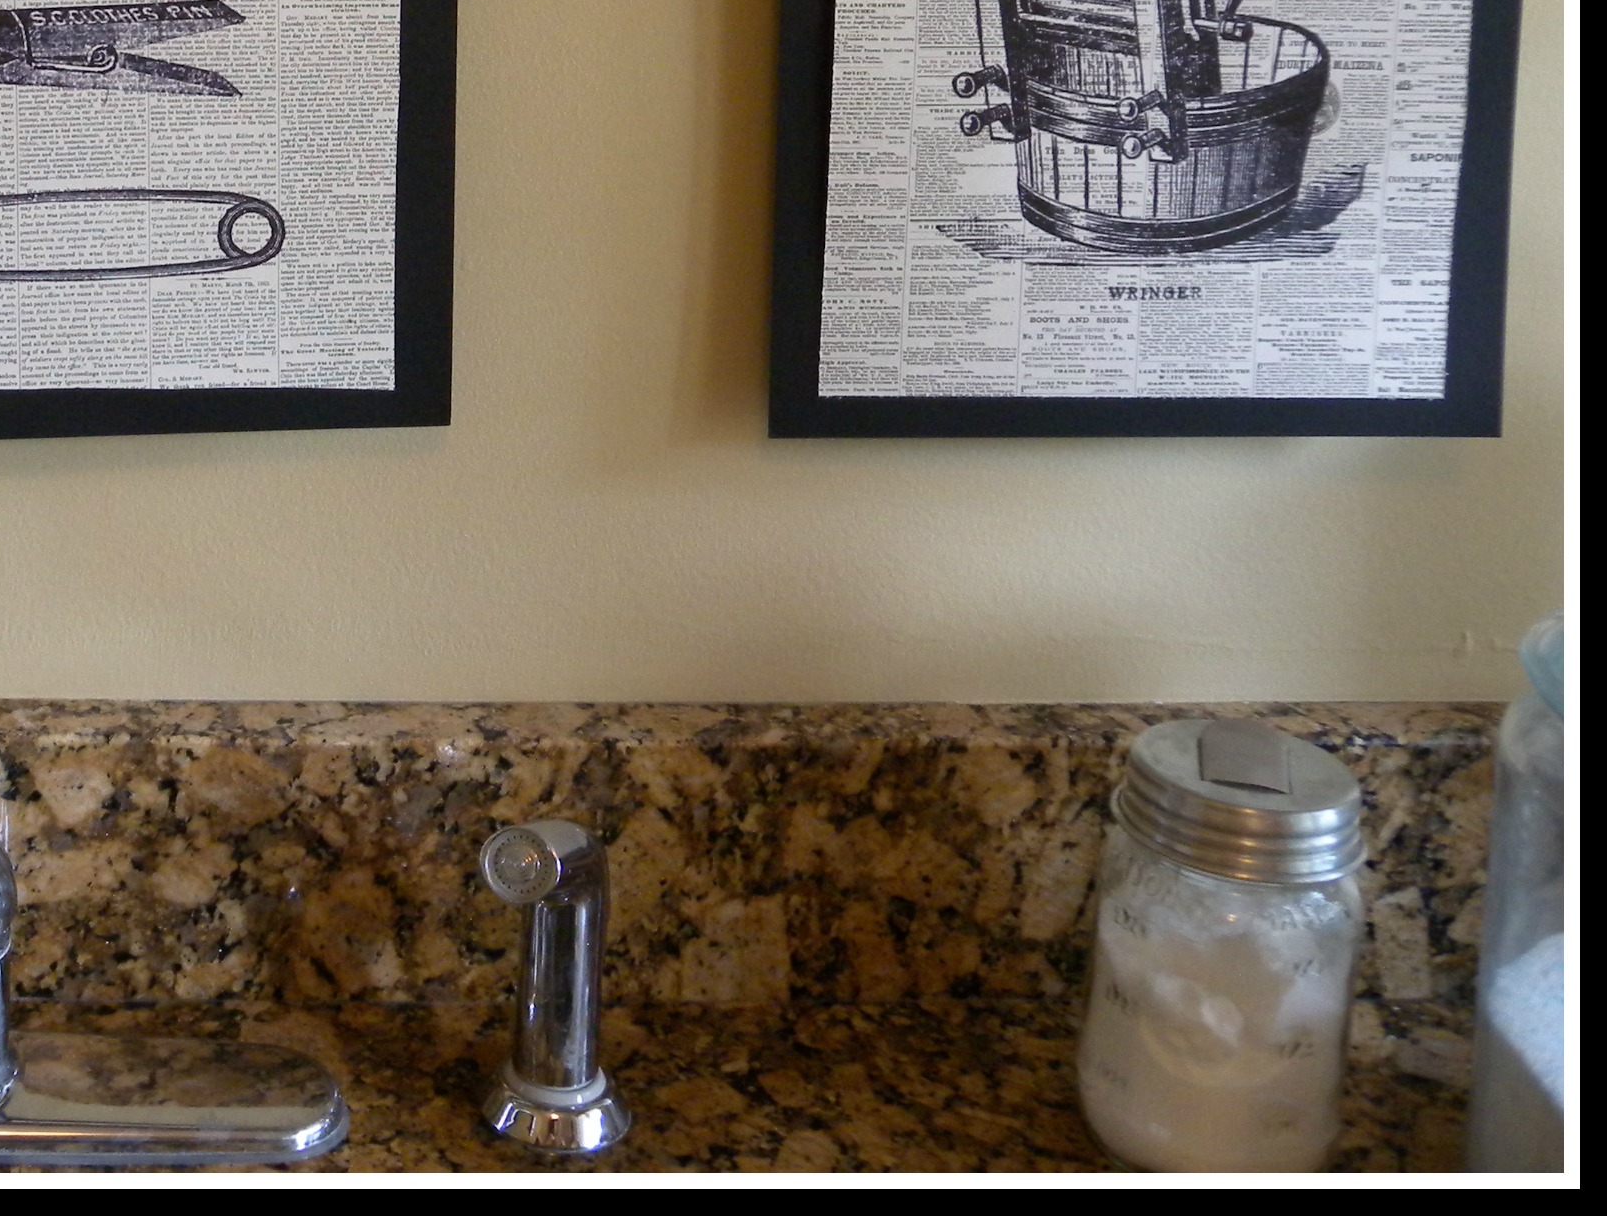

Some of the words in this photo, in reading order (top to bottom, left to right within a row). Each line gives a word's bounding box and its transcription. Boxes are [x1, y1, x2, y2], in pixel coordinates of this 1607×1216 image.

[168, 4, 213, 20] PIN
[1334, 61, 1383, 70] MAIZENA
[1108, 286, 1203, 301] WRINGER
